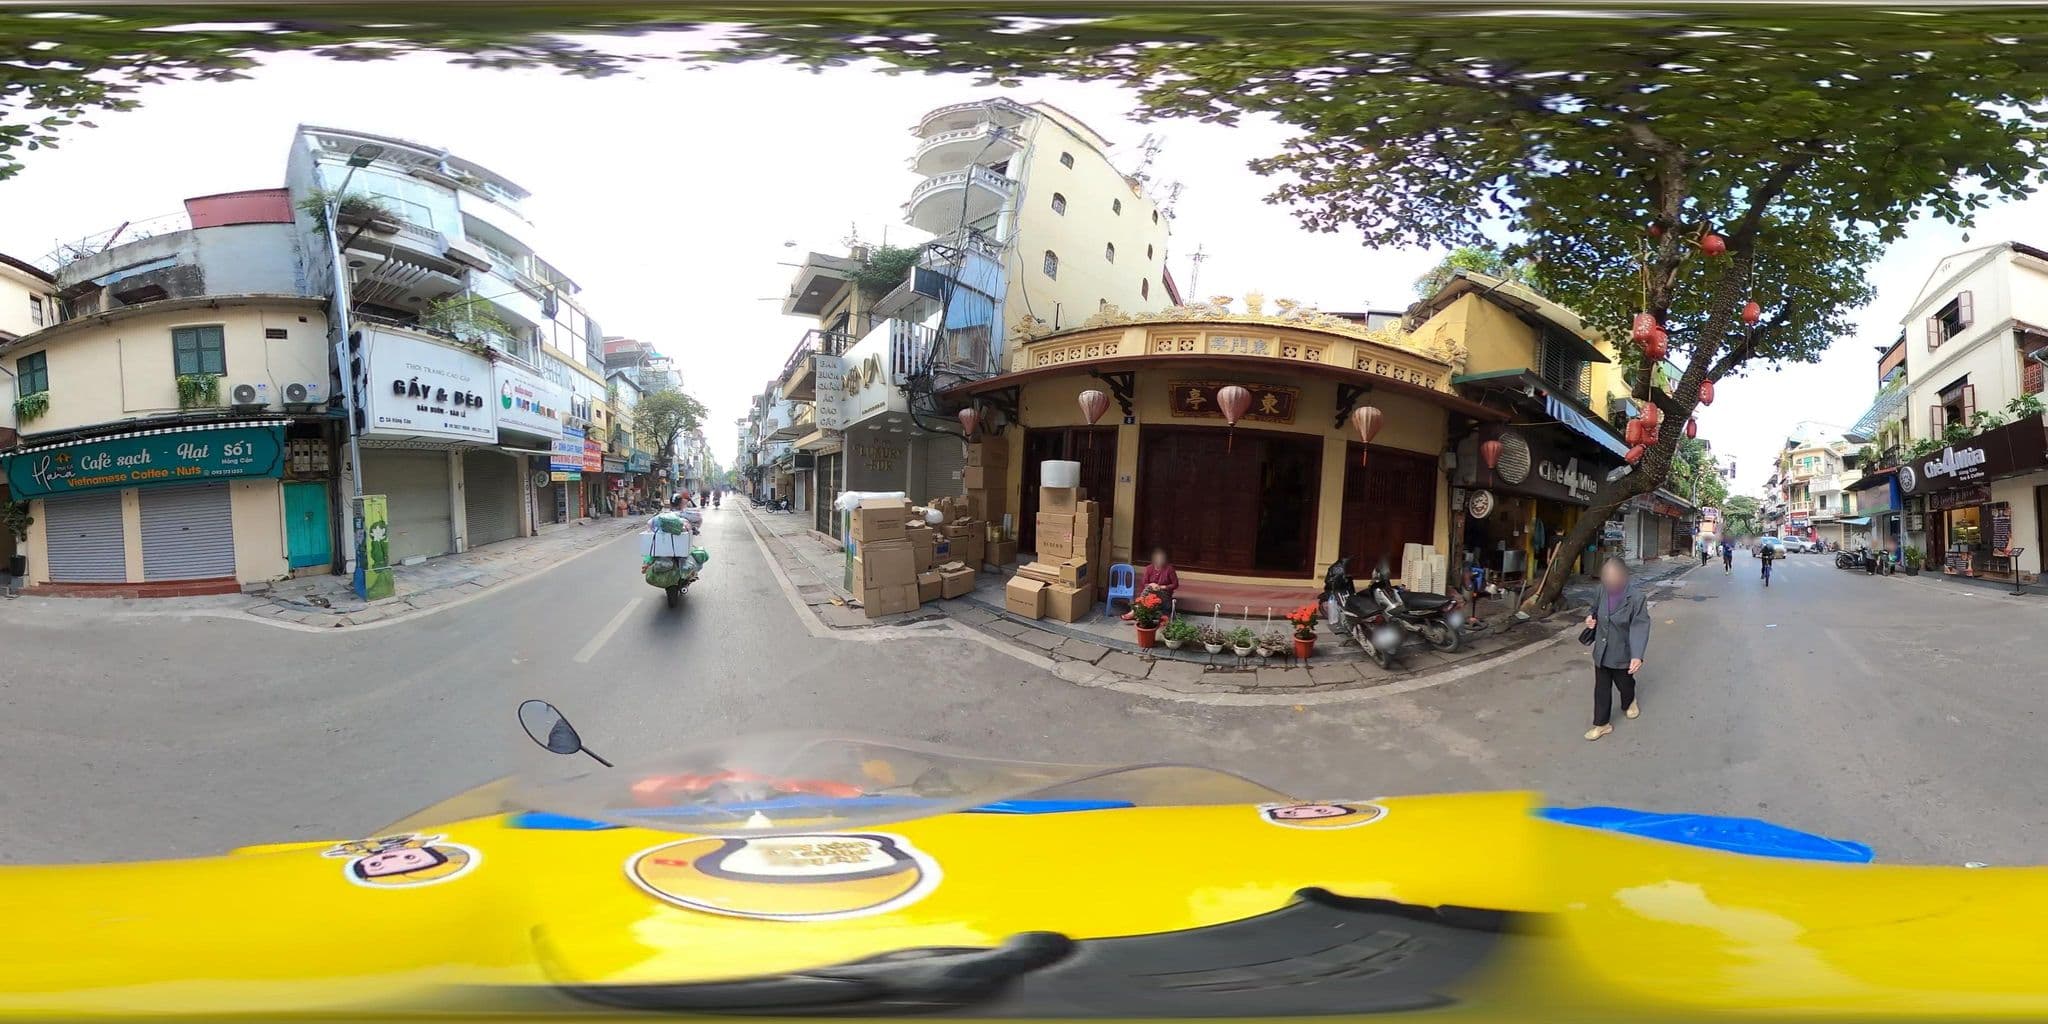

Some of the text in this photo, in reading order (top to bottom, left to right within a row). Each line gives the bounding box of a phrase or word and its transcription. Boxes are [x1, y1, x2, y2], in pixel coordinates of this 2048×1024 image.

[436, 388, 448, 403] &
[454, 390, 483, 408] BÉO
[81, 452, 112, 470] Café
[117, 448, 152, 468] sạch
[177, 443, 210, 461] Hạt
[223, 440, 253, 457] Số 1
[32, 455, 76, 491] Hana
[68, 473, 127, 487] Vietnamese
[131, 469, 168, 480] Coffee
[176, 466, 201, 476] Nuts
[1924, 458, 1944, 479] Chè
[1942, 447, 1957, 477] 4
[1954, 447, 1986, 470] Mùa
[1538, 459, 1564, 484] Chè
[1563, 457, 1579, 497] 4
